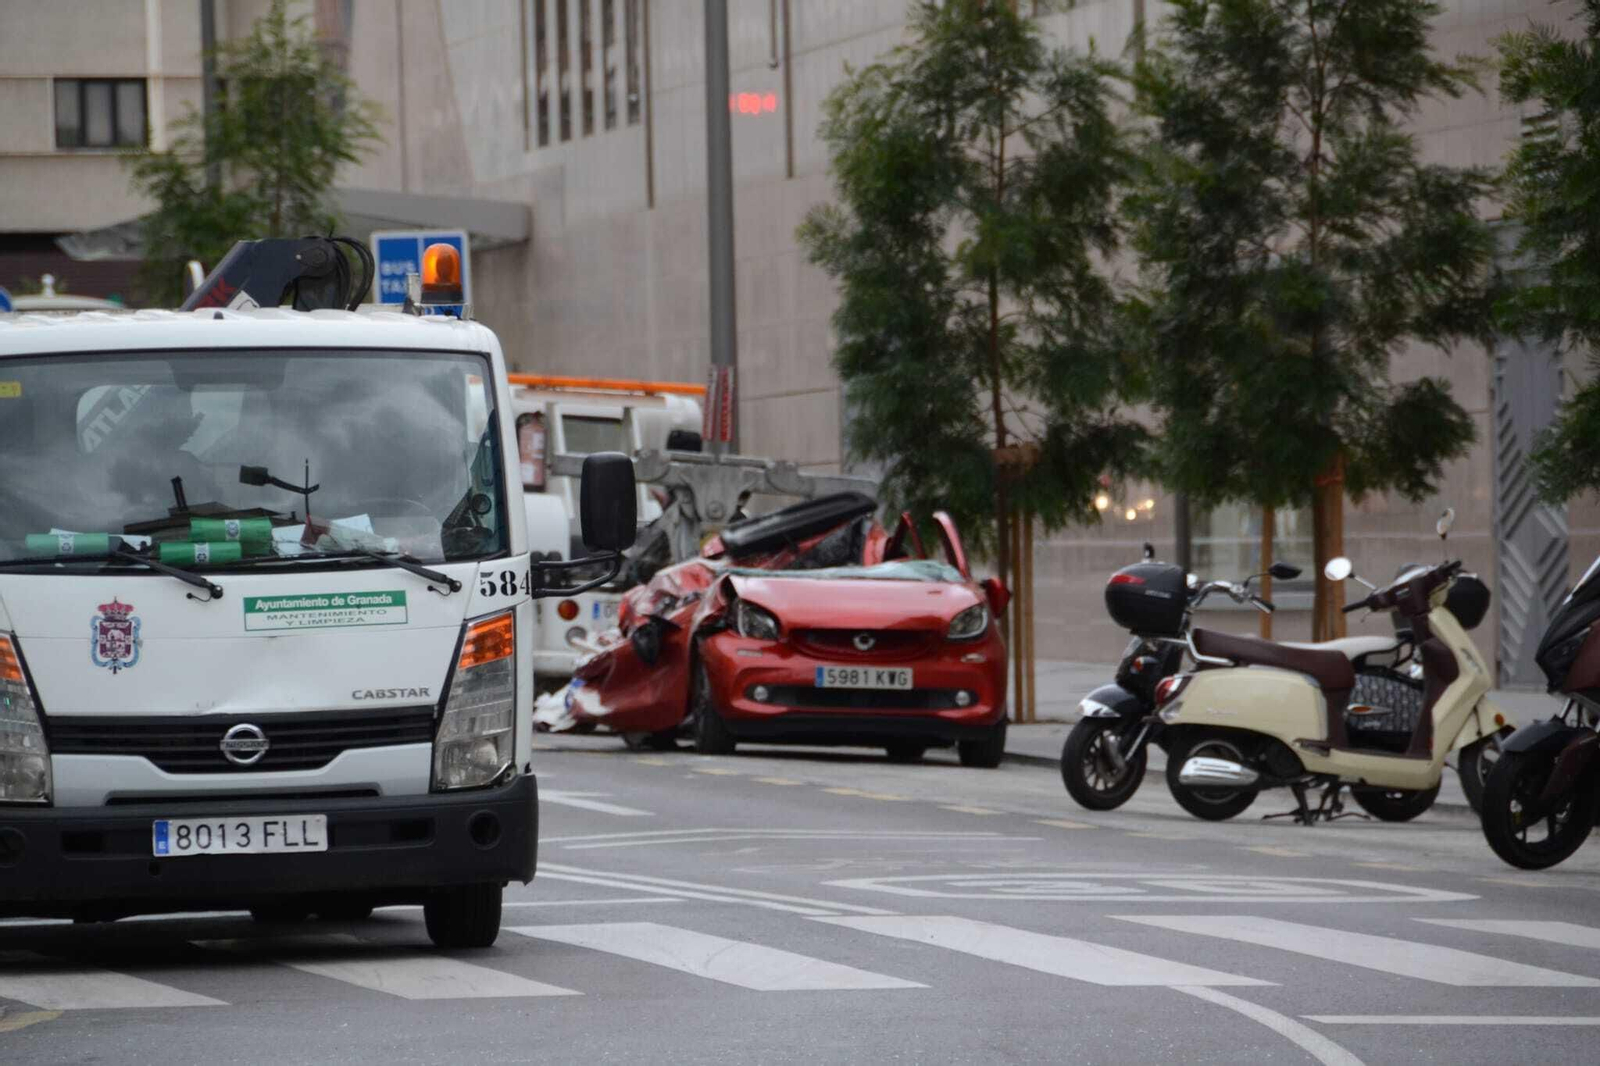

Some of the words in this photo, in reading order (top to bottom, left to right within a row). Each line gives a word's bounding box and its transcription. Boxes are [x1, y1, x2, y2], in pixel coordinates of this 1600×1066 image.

[480, 570, 531, 597] 584
[255, 598, 329, 611] Ayuntamiento
[332, 596, 345, 606] de
[347, 594, 392, 605] Granada
[266, 608, 388, 621] MANTENIMIENTO
[299, 616, 366, 626] LIMPIEZA
[827, 669, 869, 685] 5981
[351, 687, 430, 700] CABSTAR
[225, 741, 265, 749] NISSAN
[176, 822, 251, 851] 8013
[263, 820, 319, 848] FLL
